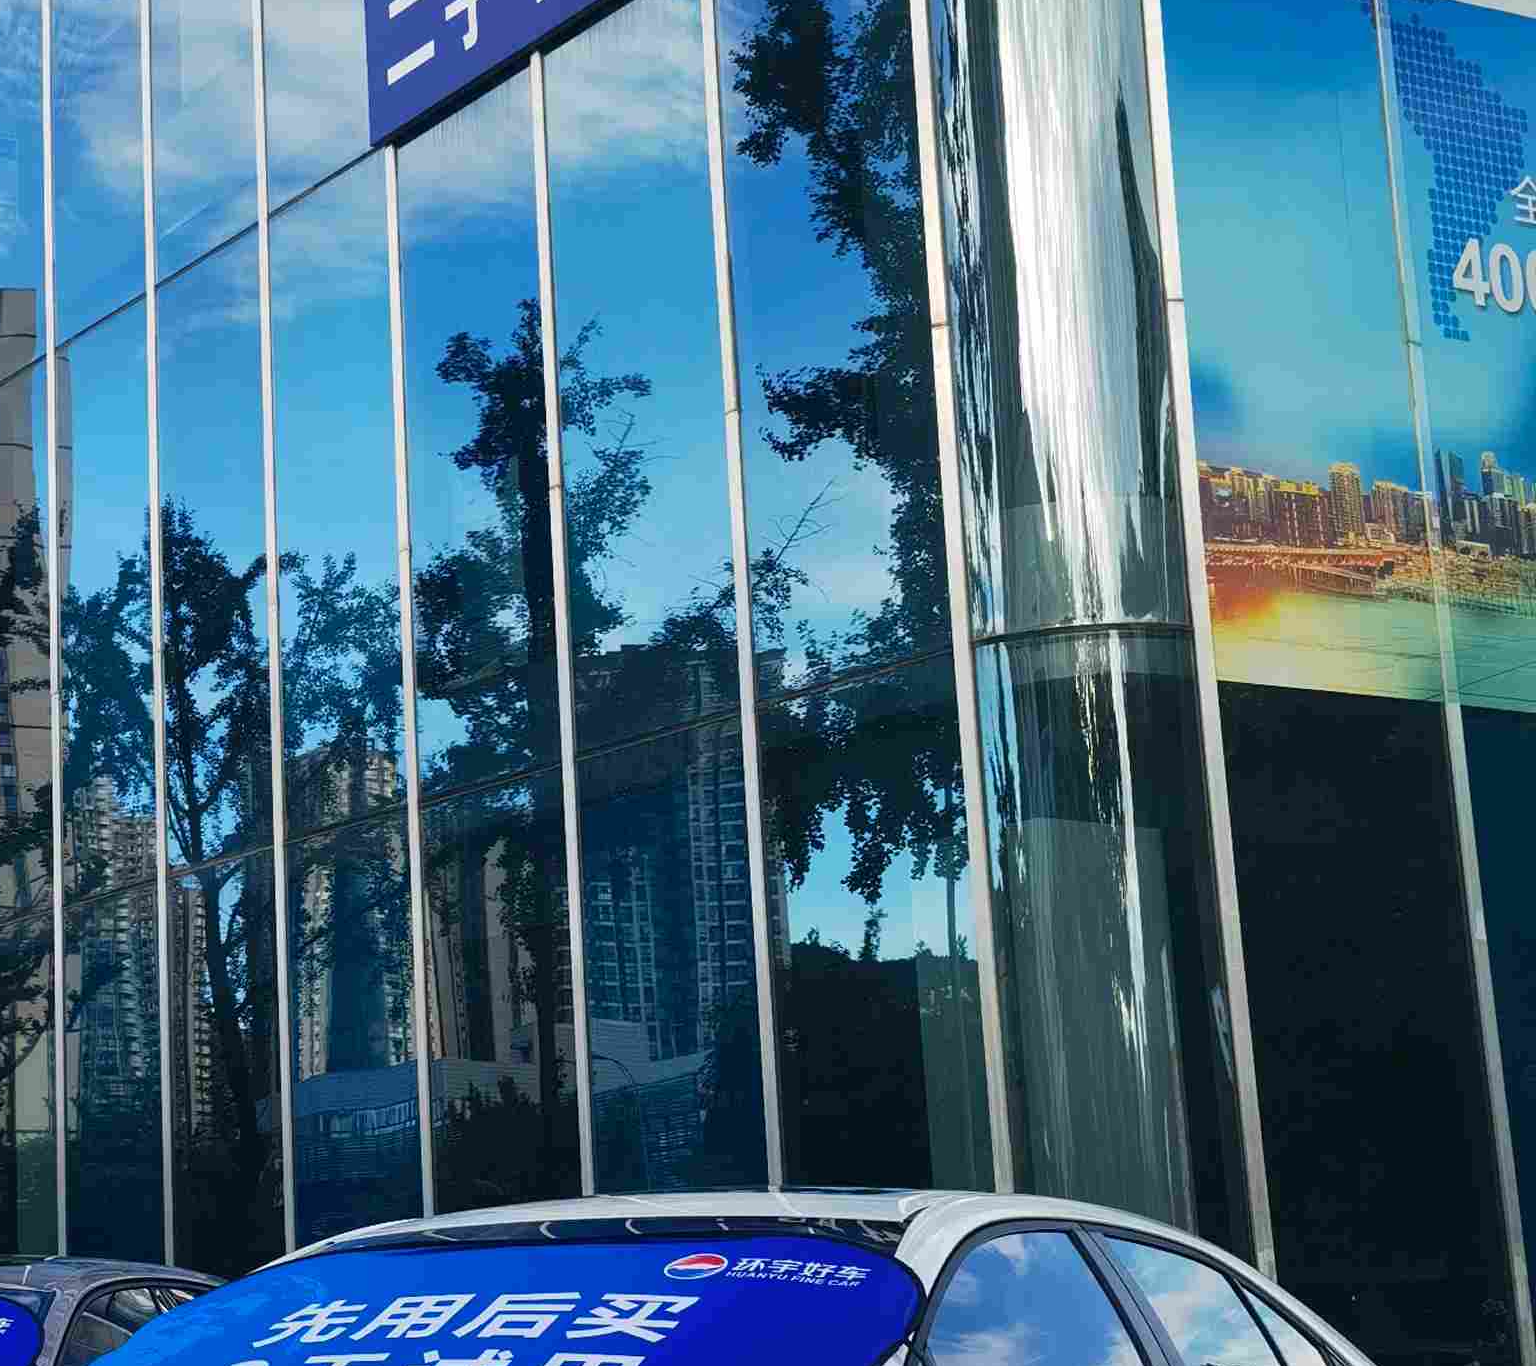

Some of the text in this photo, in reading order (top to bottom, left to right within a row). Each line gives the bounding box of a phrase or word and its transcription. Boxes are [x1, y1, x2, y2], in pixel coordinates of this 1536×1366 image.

[1452, 237, 1536, 314] 40
[725, 1271, 789, 1282] HUANYU
[792, 1275, 824, 1285] FINE
[732, 1257, 872, 1280] 环宇好车
[252, 1291, 703, 1351] 先用后买
